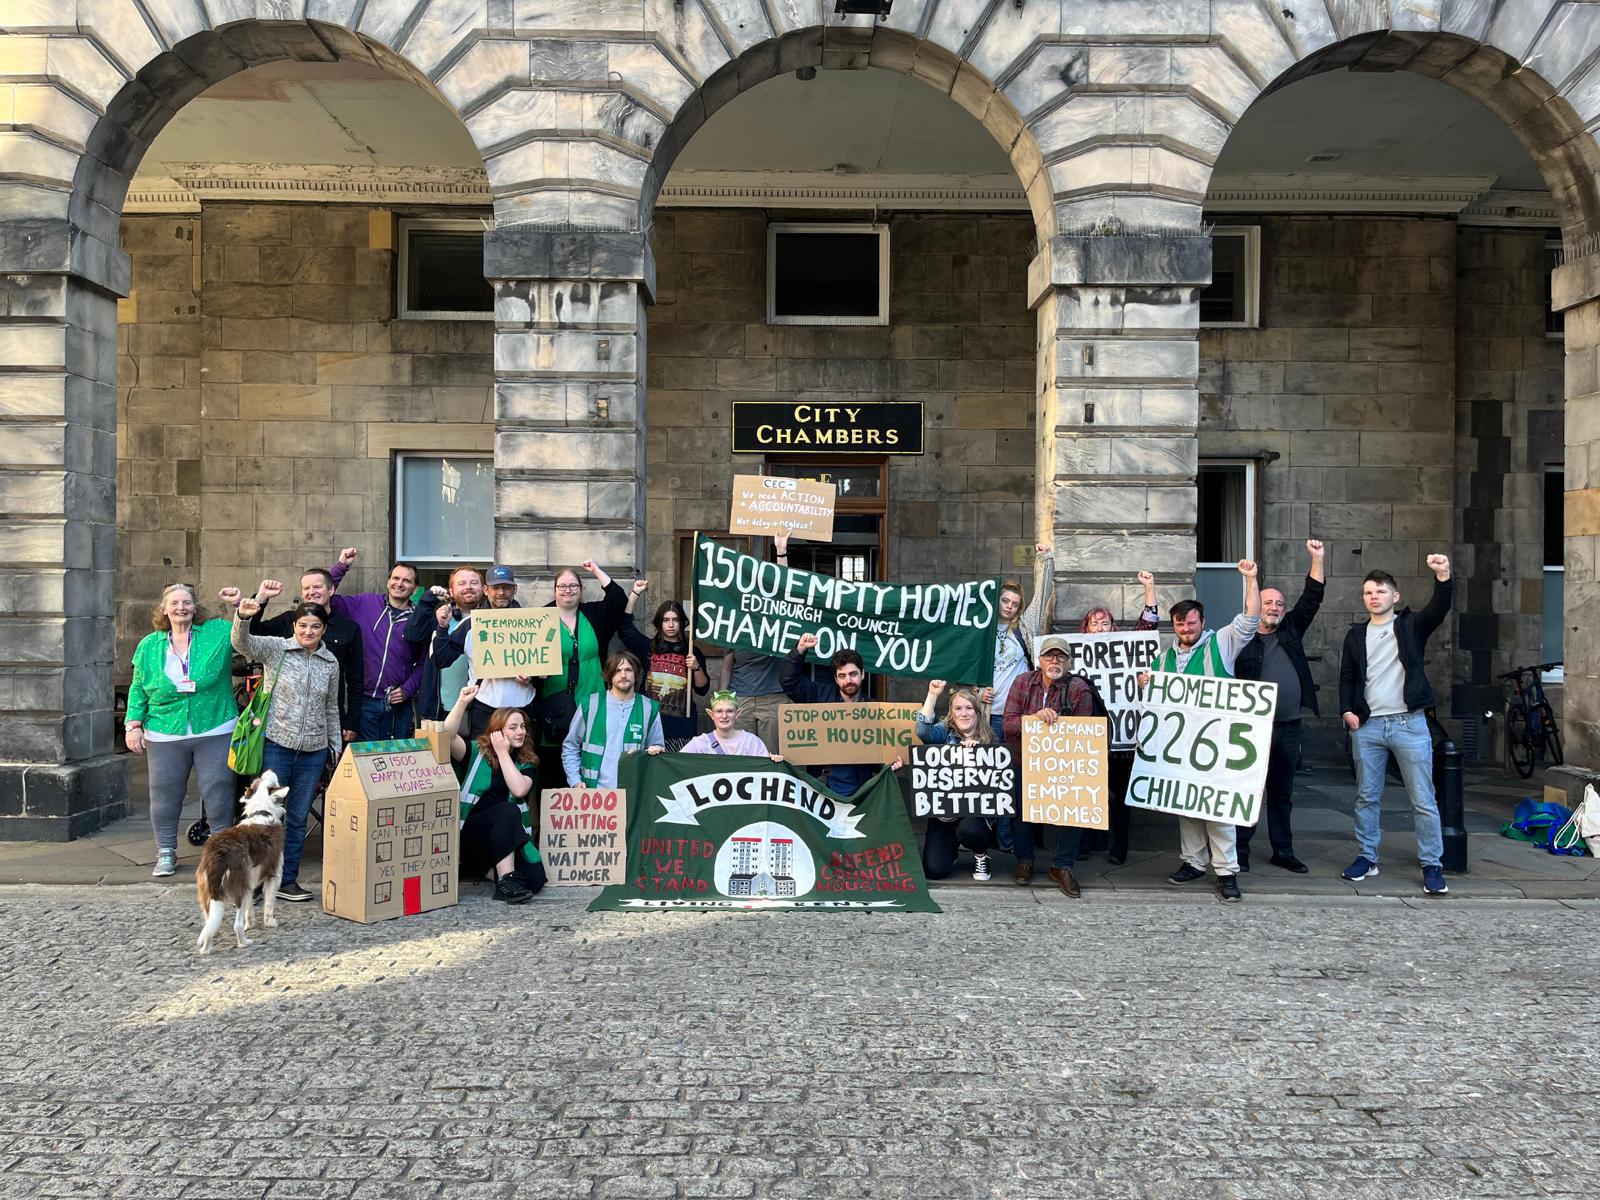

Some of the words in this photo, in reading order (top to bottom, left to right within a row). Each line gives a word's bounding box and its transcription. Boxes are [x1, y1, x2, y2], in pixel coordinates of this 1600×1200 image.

[794, 405, 861, 423] CITY
[756, 424, 899, 444] CHAMBERS
[764, 479, 786, 489] CEC
[742, 490, 754, 499] We
[758, 492, 777, 500] need
[780, 490, 825, 505] ACTION
[748, 500, 834, 518] ACCOUNTABILITY
[699, 541, 781, 598] 1500
[784, 567, 895, 615] EMPTY
[898, 579, 996, 629] HOMES
[475, 614, 550, 629] "TEMPORARY"
[741, 593, 823, 623] EDINBURGH
[836, 613, 904, 636] COUNCIL
[493, 632, 505, 645] IS
[509, 631, 537, 645] NOT
[695, 601, 802, 654] SHAME
[814, 626, 857, 659] ON
[874, 634, 932, 673] YOU
[482, 649, 495, 666] A
[503, 646, 550, 667] HOME
[1069, 639, 1159, 670] FOREVER
[1148, 674, 1275, 717] HOMELESS
[783, 708, 819, 724] STOP
[786, 728, 817, 741] OUR
[826, 727, 913, 748] HOUSING
[1024, 720, 1044, 736] WE
[1049, 720, 1105, 737] DEMAND
[1028, 735, 1100, 754] SOCIAL
[1137, 709, 1258, 772] 2265
[389, 755, 417, 768] 1500
[912, 745, 1012, 769] LOCHEND
[1028, 756, 1099, 776] HOMES
[370, 770, 403, 783] EMPTY
[408, 765, 453, 779] COUNCIL
[912, 767, 1015, 791] DESERVES
[1047, 775, 1076, 785] NOT
[393, 779, 434, 793] HOMES
[1027, 783, 1102, 805] EMPTY
[686, 776, 836, 821] LOCHEND
[914, 791, 1016, 817] BETTER
[1129, 775, 1255, 822] CHILDREN
[550, 813, 618, 831] WAITING
[1029, 804, 1103, 824] HOMES
[370, 828, 391, 841] CAN
[393, 823, 419, 837] THEY
[421, 819, 438, 832] FIX
[440, 816, 457, 828] IT?
[547, 833, 568, 848] WE
[641, 837, 715, 859] UNITED
[547, 850, 590, 867] WAIT
[593, 850, 621, 867] ANY
[831, 841, 905, 868] DEFEND
[378, 864, 396, 878] YES
[400, 858, 427, 873] THEY
[429, 854, 451, 869] CAN!
[557, 868, 611, 882] LONGER
[653, 858, 685, 876] WE
[821, 861, 910, 880] COUNCIL
[634, 874, 710, 893] STAND
[816, 877, 918, 893] HOUSING
